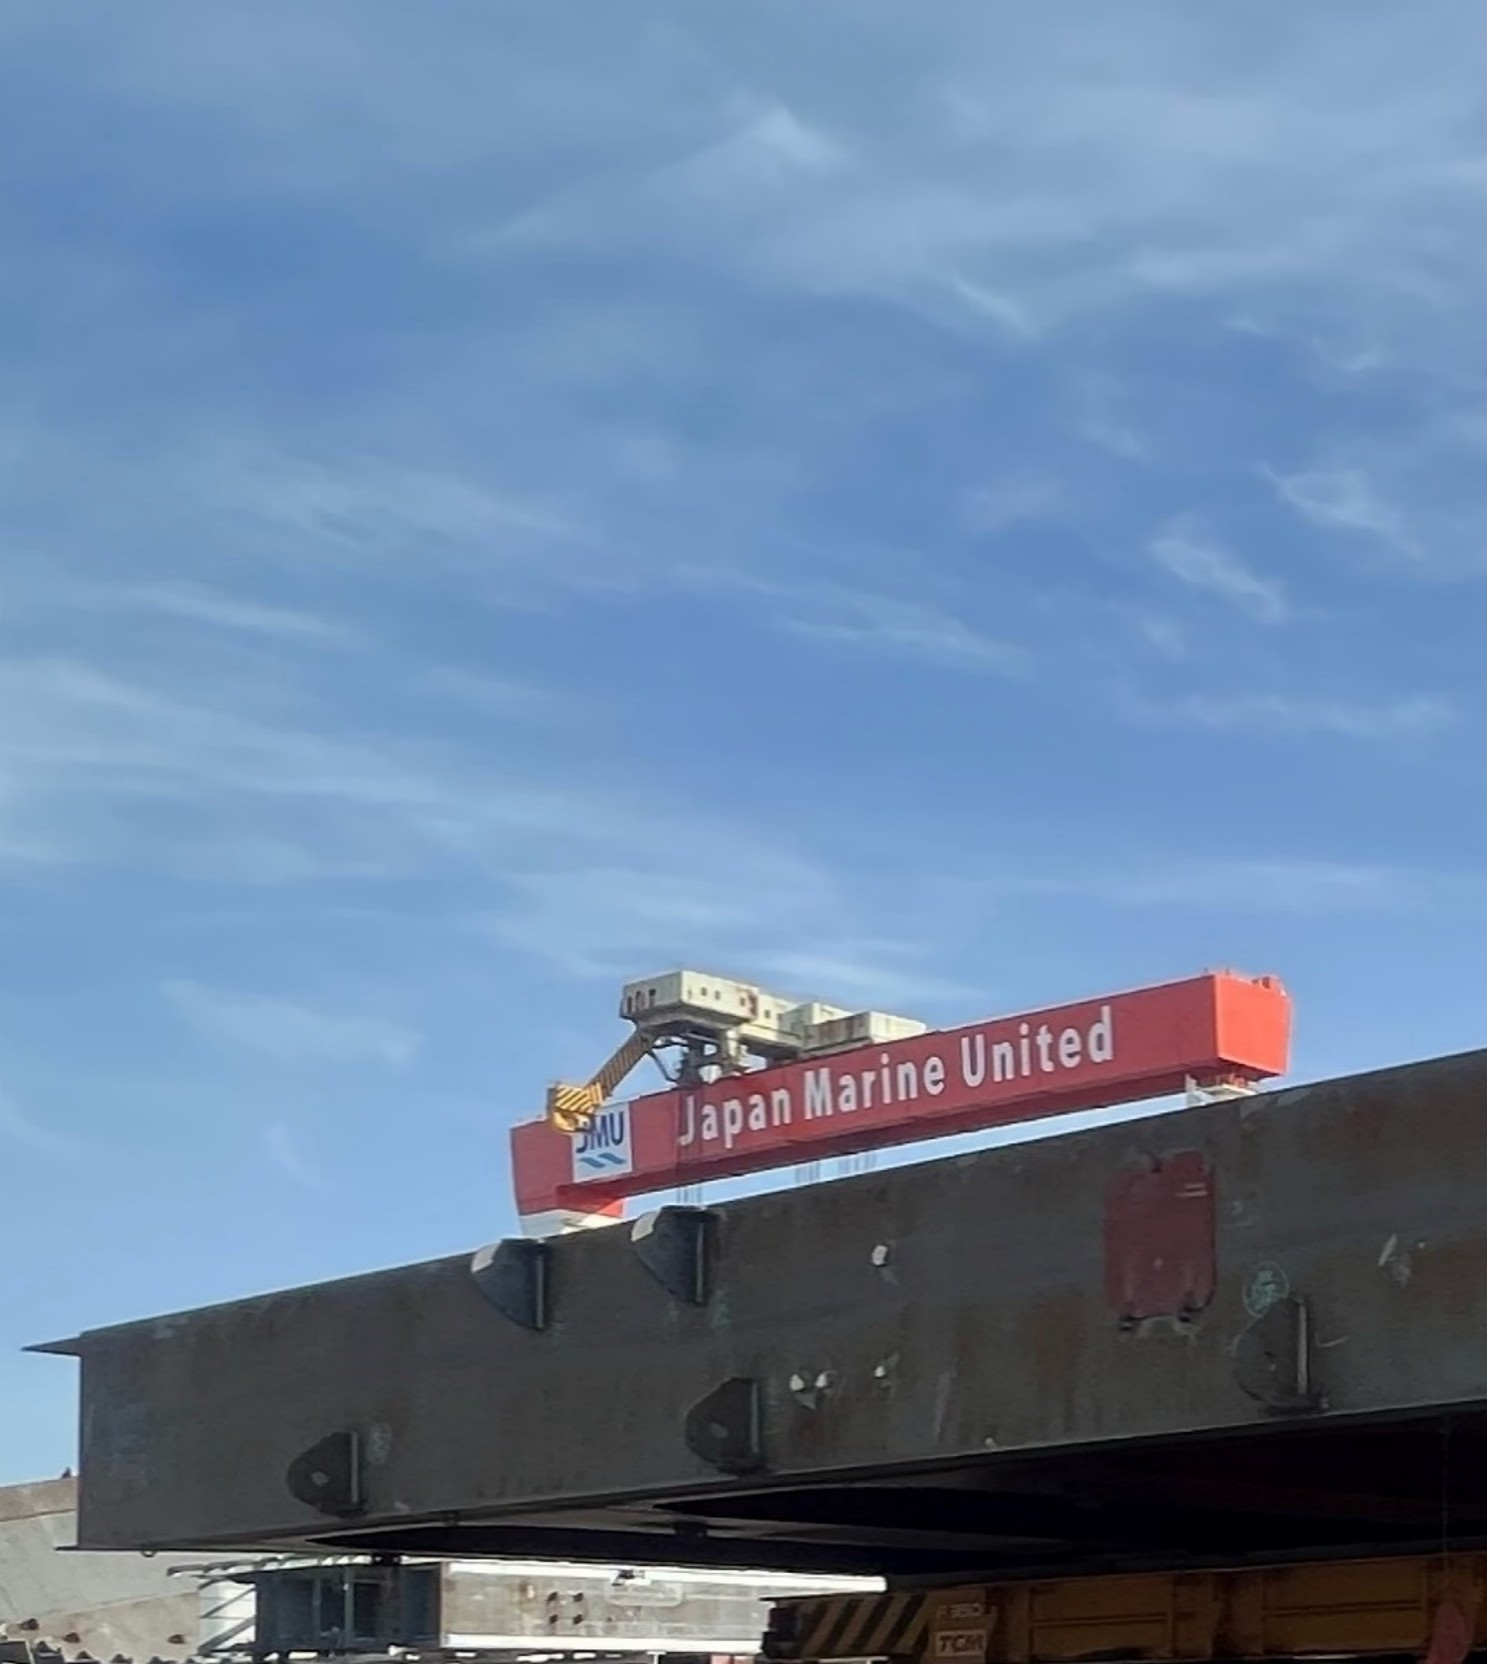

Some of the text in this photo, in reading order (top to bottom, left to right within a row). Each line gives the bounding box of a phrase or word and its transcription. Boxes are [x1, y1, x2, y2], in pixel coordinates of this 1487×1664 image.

[678, 1004, 1114, 1149] Japan Marine United
